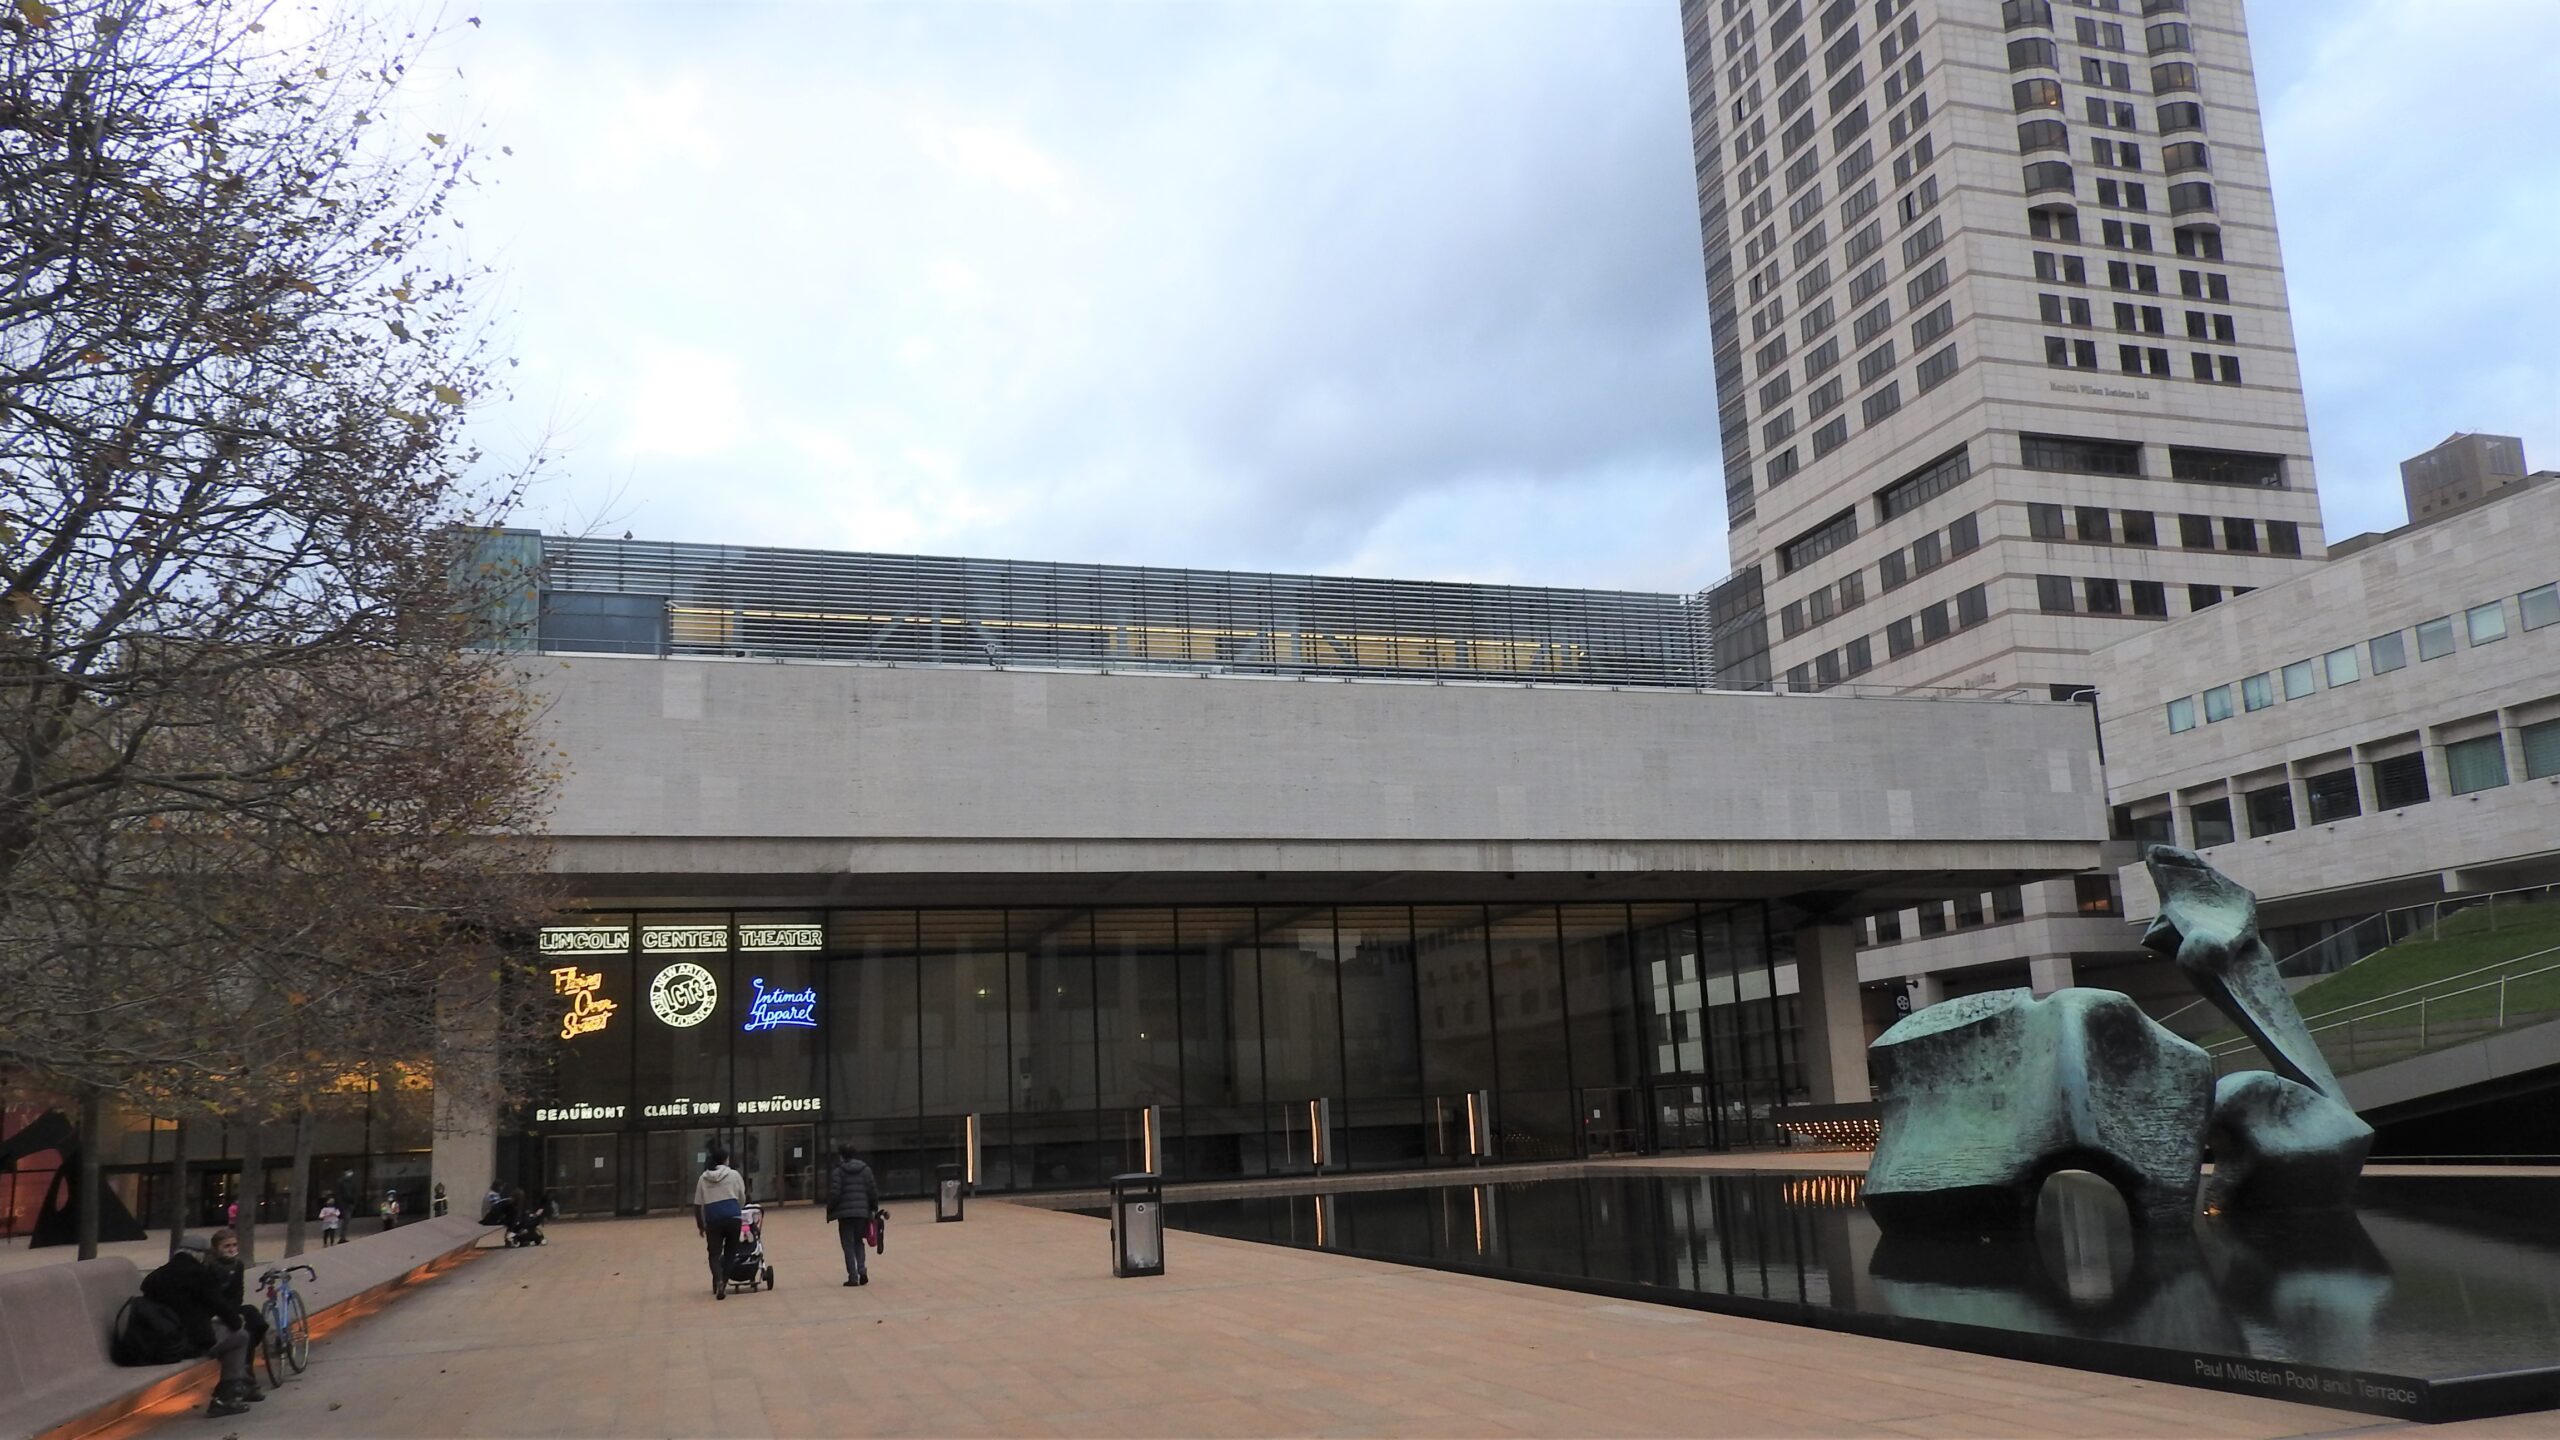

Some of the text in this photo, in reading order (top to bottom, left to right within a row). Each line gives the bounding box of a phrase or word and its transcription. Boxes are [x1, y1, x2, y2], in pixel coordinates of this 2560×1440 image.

[539, 929, 822, 950] LINCOLN CENTER THEATER
[655, 964, 714, 989] NEW ARTISTS
[663, 977, 706, 1013] LCT3
[753, 978, 817, 1013] Intimate
[652, 991, 715, 1026] NEW AUDIENCES
[744, 1003, 818, 1031] Apparel
[536, 1105, 626, 1121] BEAUMONT
[644, 1102, 721, 1117] CLAIRE TOW
[737, 1098, 822, 1114] NEWHOUSE
[2194, 1358, 2418, 1405] Paul Milstein Pool and Terrace
